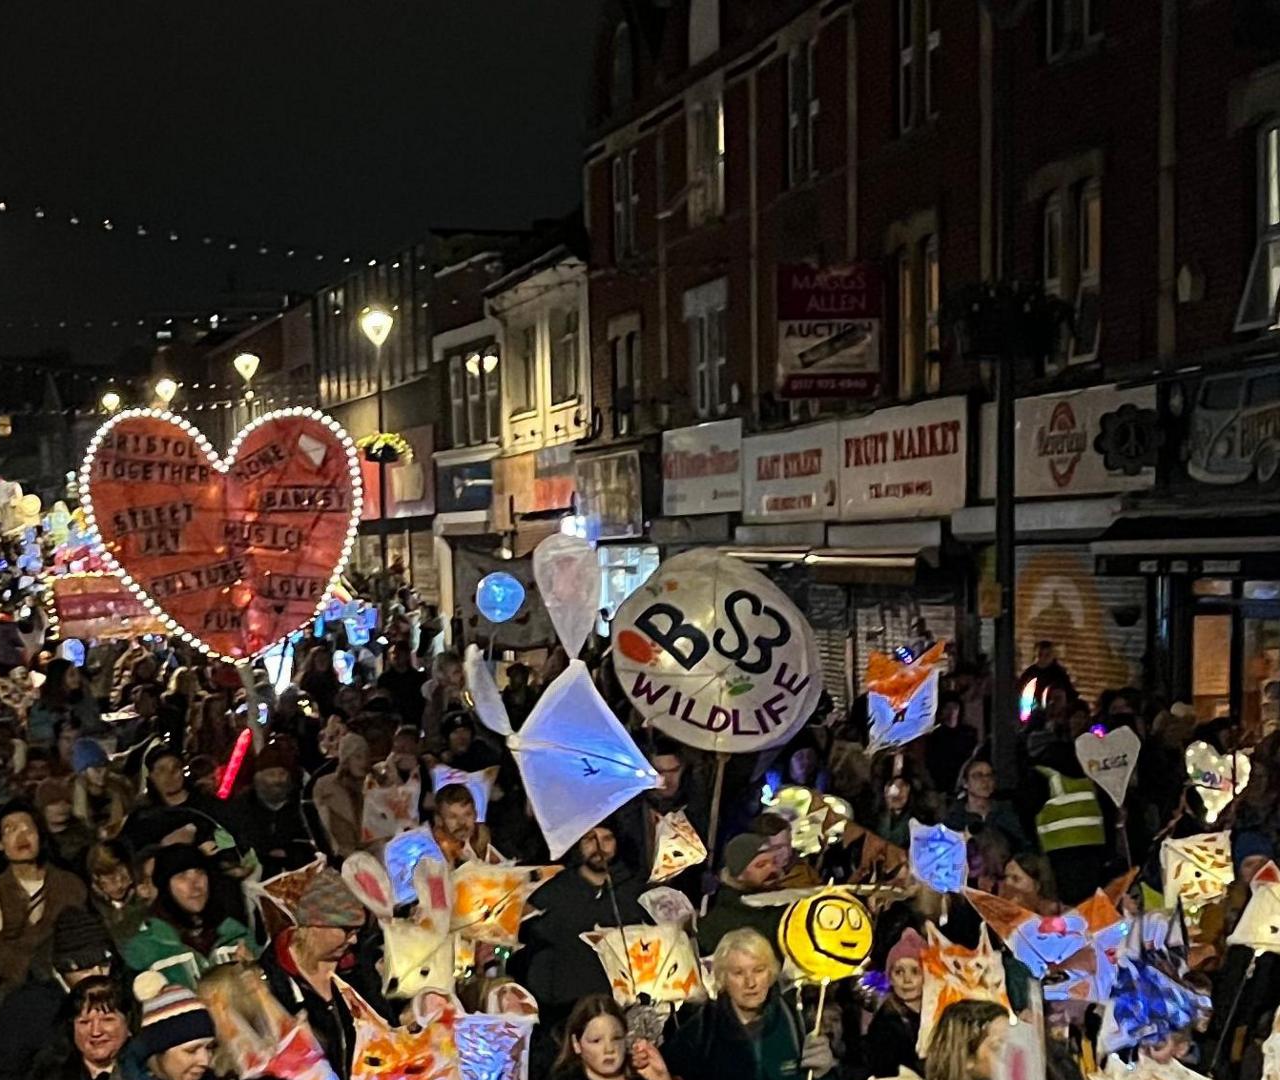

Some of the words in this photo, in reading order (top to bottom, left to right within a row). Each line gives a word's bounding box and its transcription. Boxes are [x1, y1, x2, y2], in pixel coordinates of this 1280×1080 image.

[791, 273, 866, 290] MAGGS
[807, 293, 866, 313] ALLEN
[102, 433, 197, 459] BRISTOL
[844, 431, 888, 468] FRUIT
[892, 420, 960, 461] MARKET
[99, 460, 209, 483] TOGETHER
[113, 503, 193, 533] STREET
[150, 560, 245, 596] CULTURE
[204, 612, 242, 630] FUN
[634, 589, 792, 674] BS3
[631, 662, 811, 736] WILDLIFE
